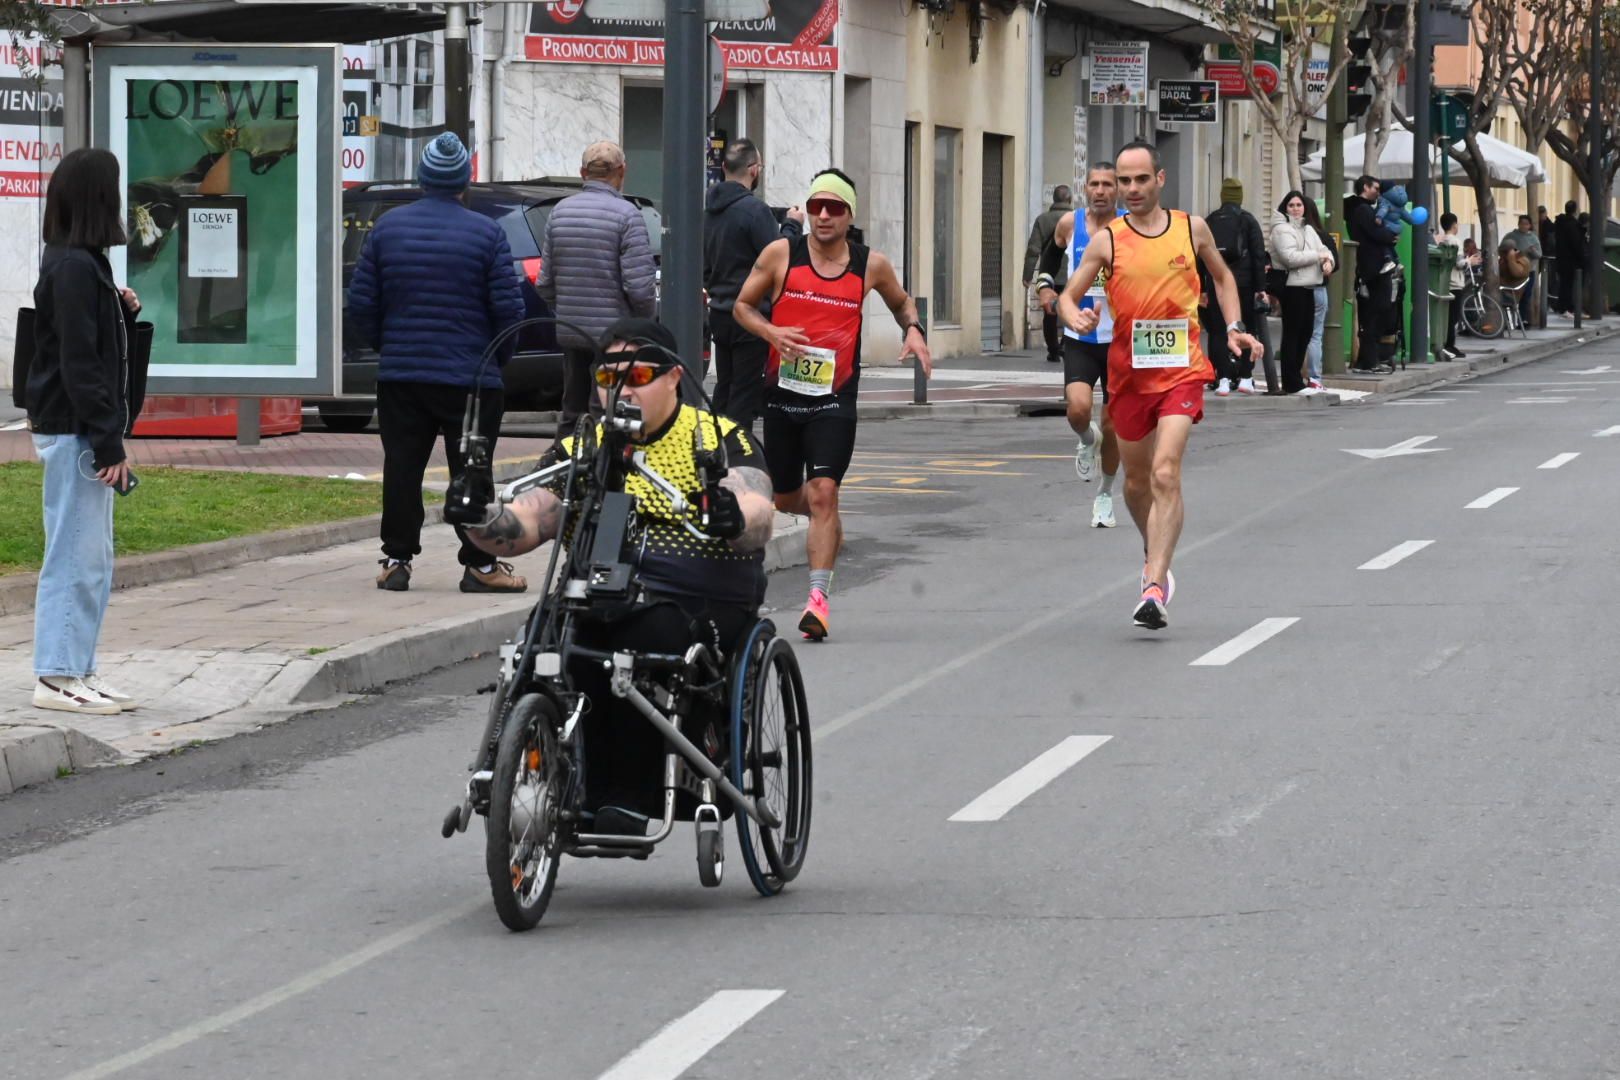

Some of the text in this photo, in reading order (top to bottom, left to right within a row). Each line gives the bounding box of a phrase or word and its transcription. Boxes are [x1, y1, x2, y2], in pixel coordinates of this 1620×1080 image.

[541, 37, 628, 60] PROMOCIÓN
[764, 46, 832, 66] CASTALIA
[125, 79, 299, 120] LOEWE
[1160, 91, 1192, 100] BADAL
[193, 212, 233, 224] LOEWE
[1144, 331, 1176, 348] 169
[794, 357, 824, 377] 137
